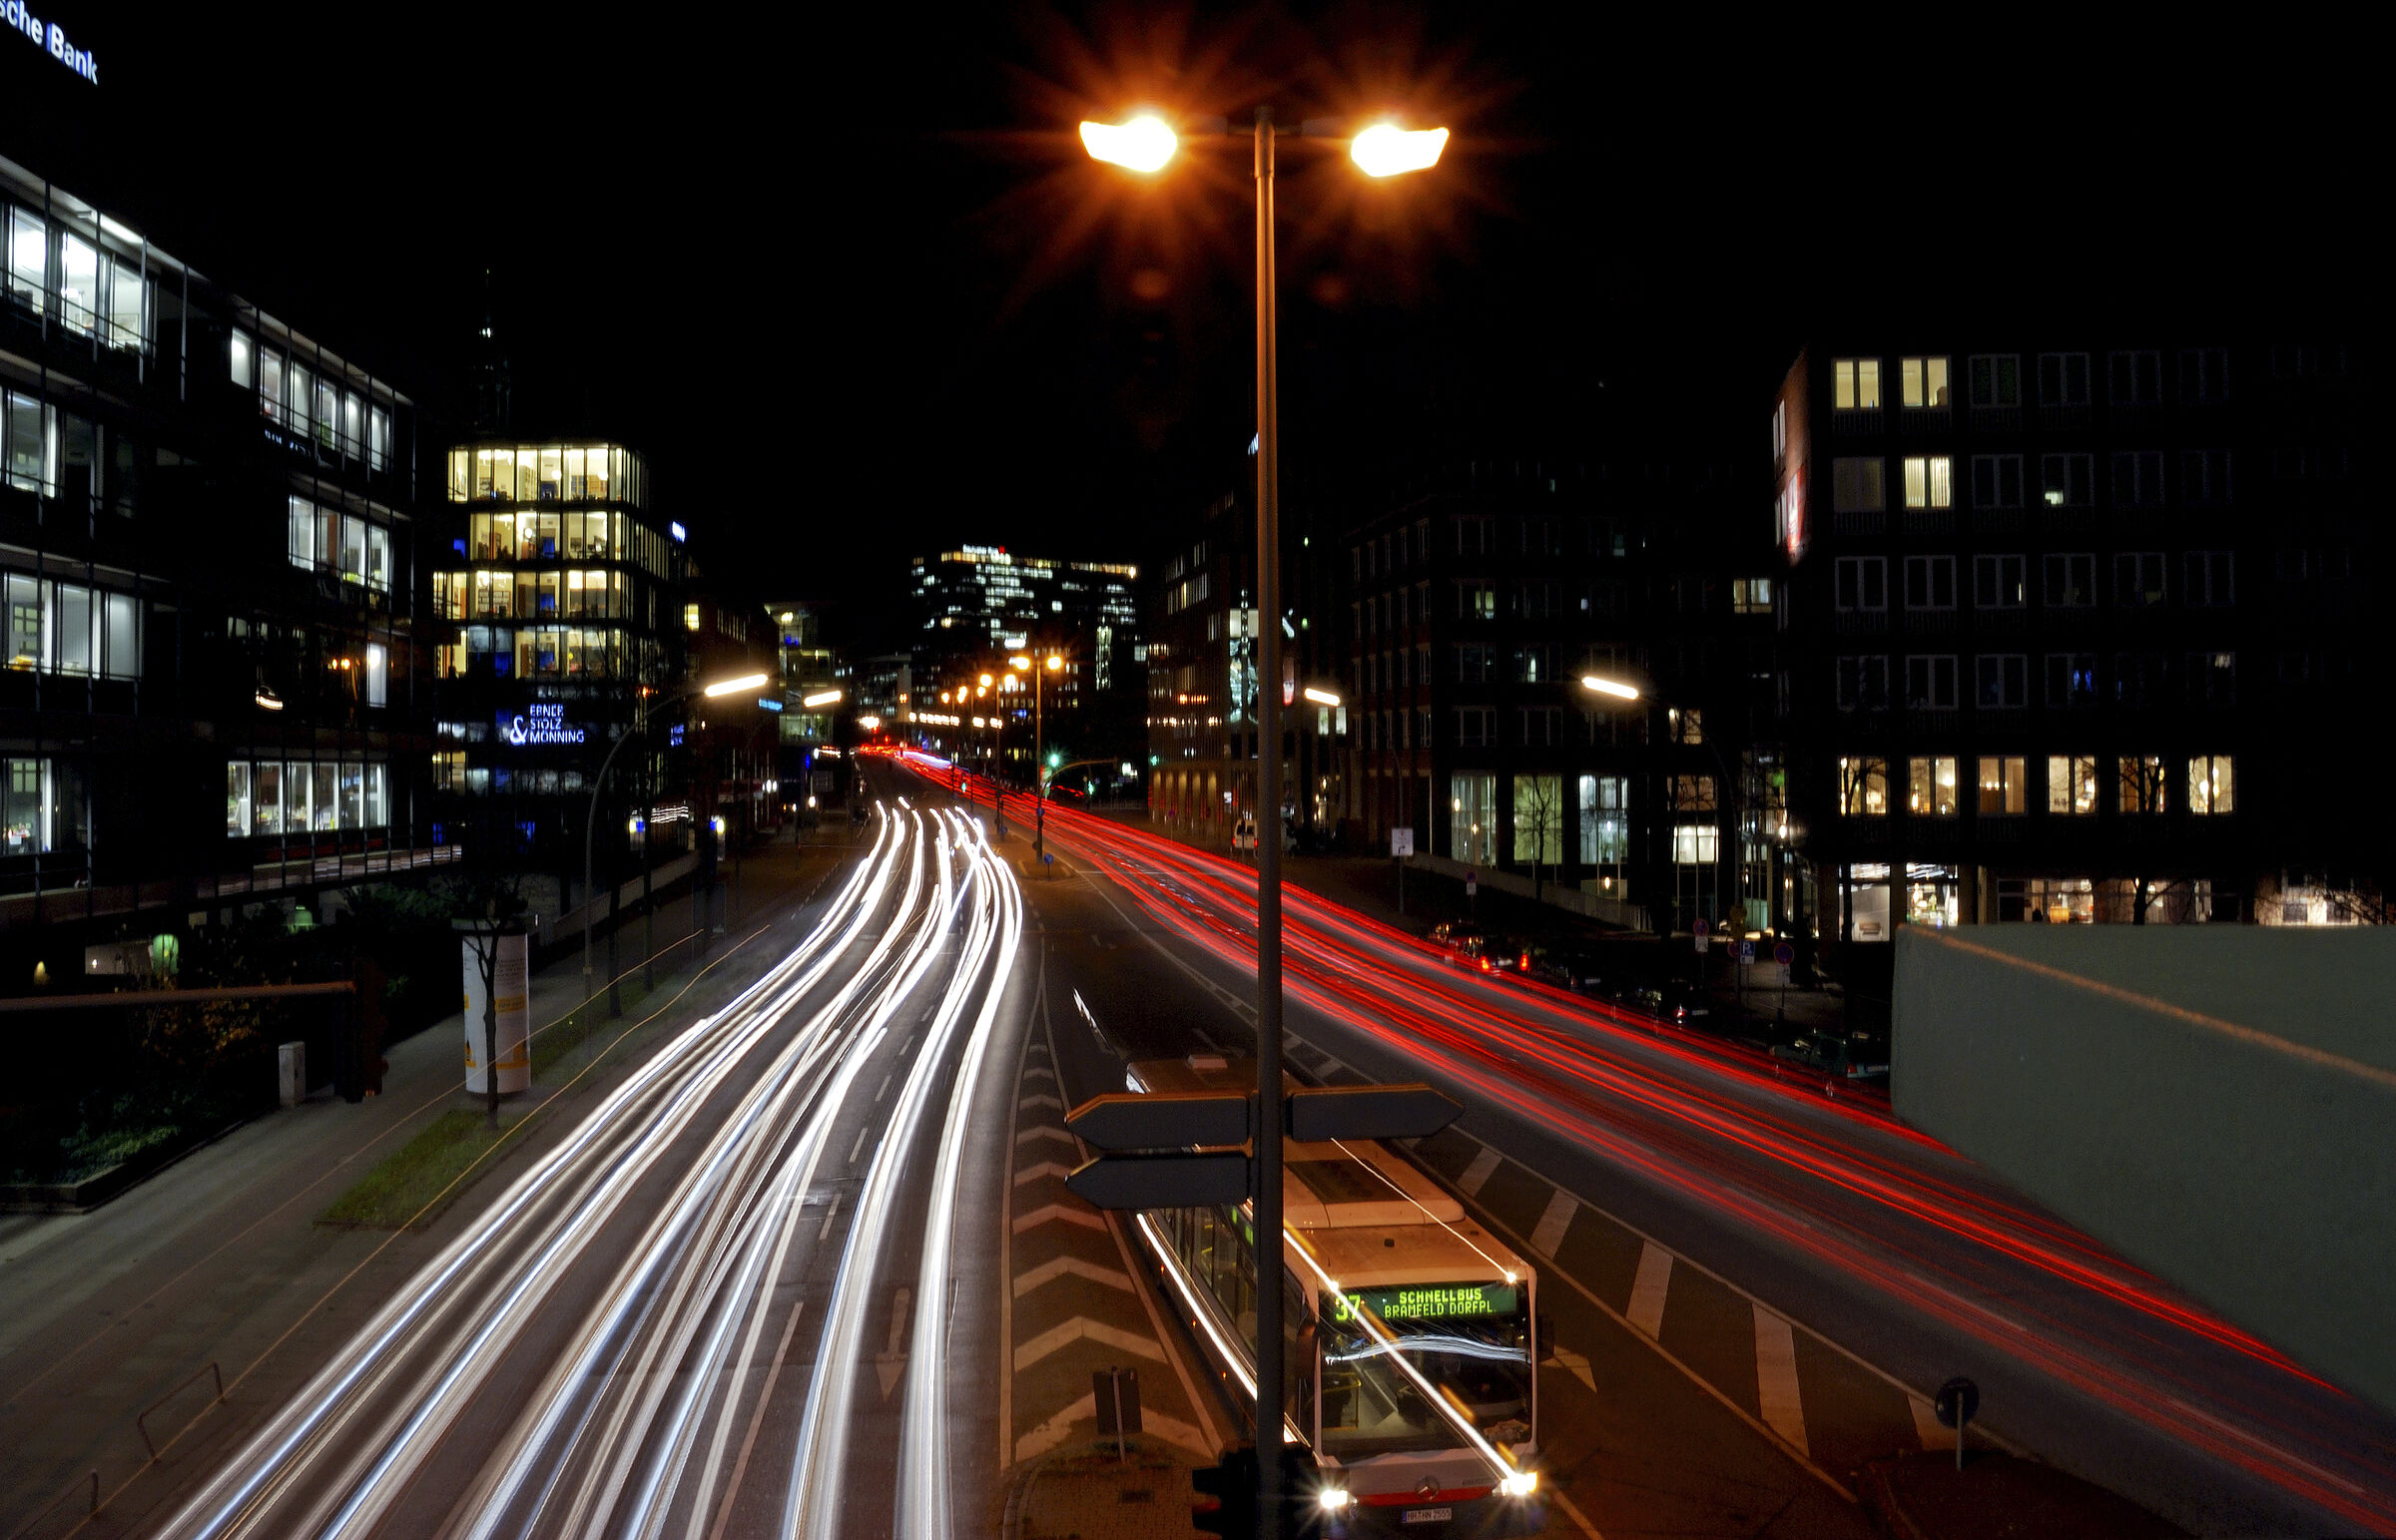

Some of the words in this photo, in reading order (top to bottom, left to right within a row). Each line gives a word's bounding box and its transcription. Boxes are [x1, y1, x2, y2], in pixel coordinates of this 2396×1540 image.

[50, 23, 98, 86] Bank
[529, 703, 564, 718] EBNER
[509, 715, 528, 746] &
[529, 717, 562, 731] STOLZ
[1399, 1287, 1483, 1304] SCHNELLBUS
[1384, 1301, 1445, 1318] BRAMFELD
